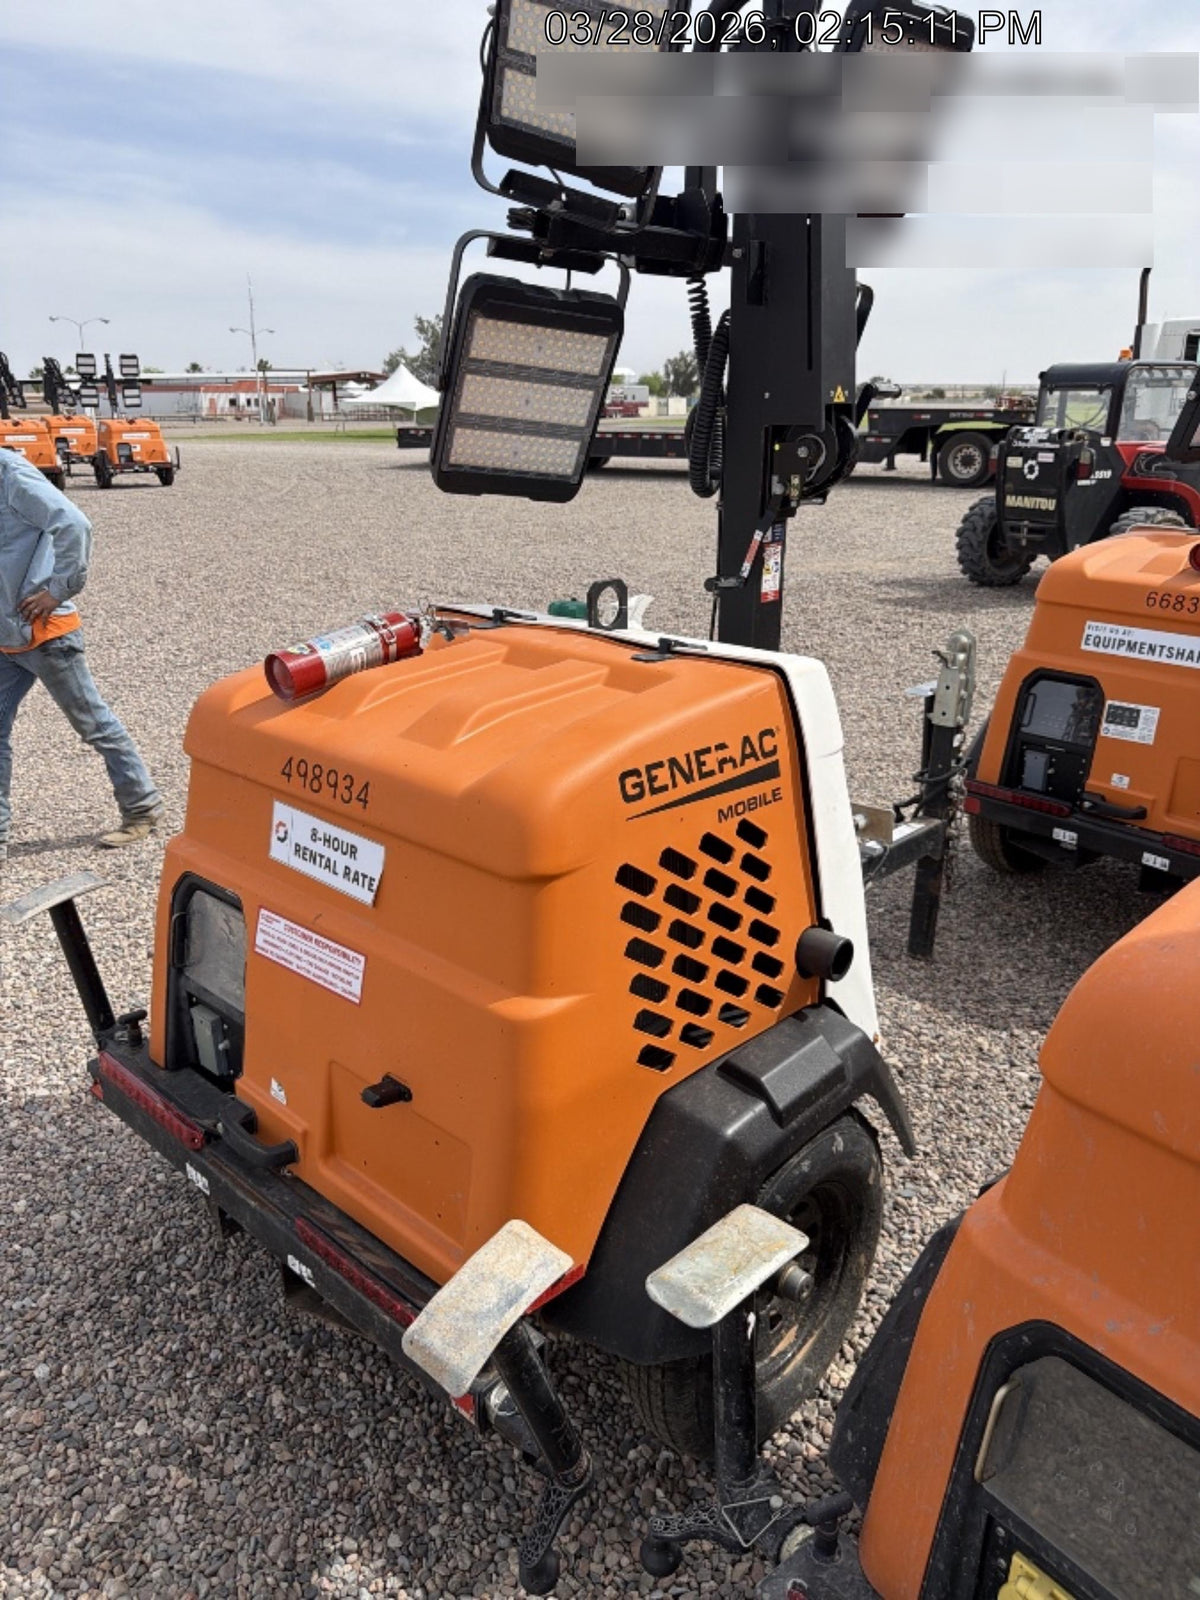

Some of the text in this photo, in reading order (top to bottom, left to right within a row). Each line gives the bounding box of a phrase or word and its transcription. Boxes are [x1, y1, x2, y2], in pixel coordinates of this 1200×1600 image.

[1006, 496, 1056, 511] MANITOU
[1146, 591, 1200, 614] 6683
[281, 756, 370, 809] 498934
[618, 729, 778, 803] GENERAC
[717, 786, 783, 824] MOBILE
[310, 828, 358, 860] 8-HOUR
[293, 845, 376, 893] RENTAL RATE
